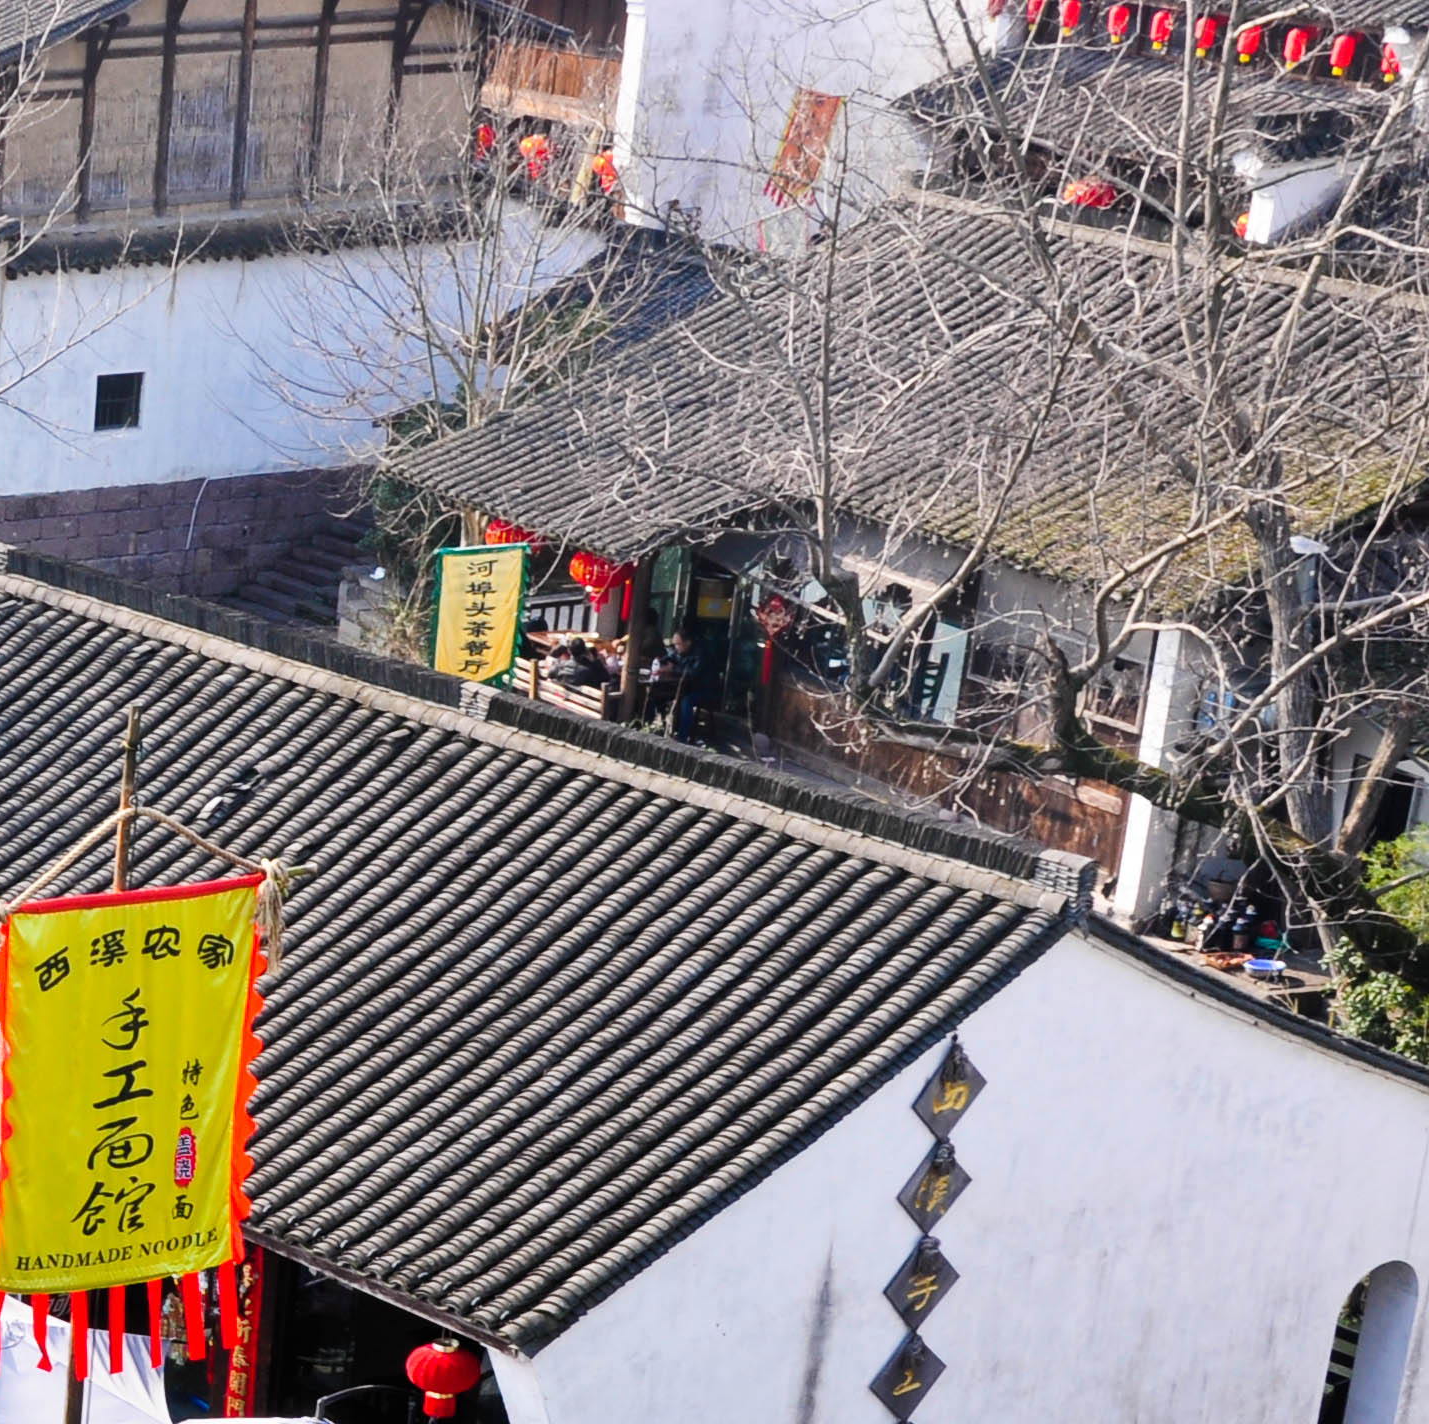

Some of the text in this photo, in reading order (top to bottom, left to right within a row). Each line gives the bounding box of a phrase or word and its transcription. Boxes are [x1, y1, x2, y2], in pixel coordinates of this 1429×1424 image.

[458, 559, 499, 675] 河埠头茶餐厅
[34, 924, 235, 992] 西溪农家
[15, 1227, 218, 1271] HANDMADE NOODLE
